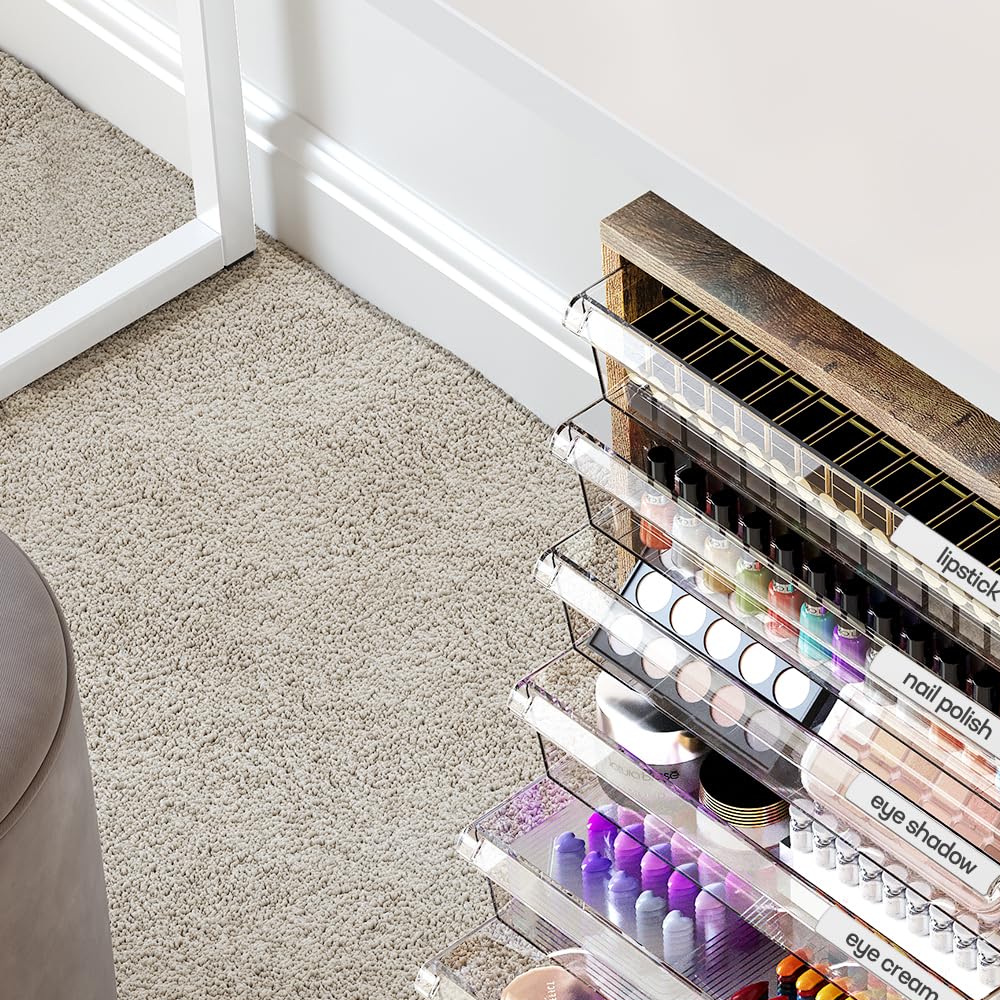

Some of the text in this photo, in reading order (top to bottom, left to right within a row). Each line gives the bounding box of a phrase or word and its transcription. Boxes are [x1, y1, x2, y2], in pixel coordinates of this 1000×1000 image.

[902, 672, 992, 740] nail polish
[870, 795, 978, 875] eye shadow
[845, 933, 880, 962] eye
